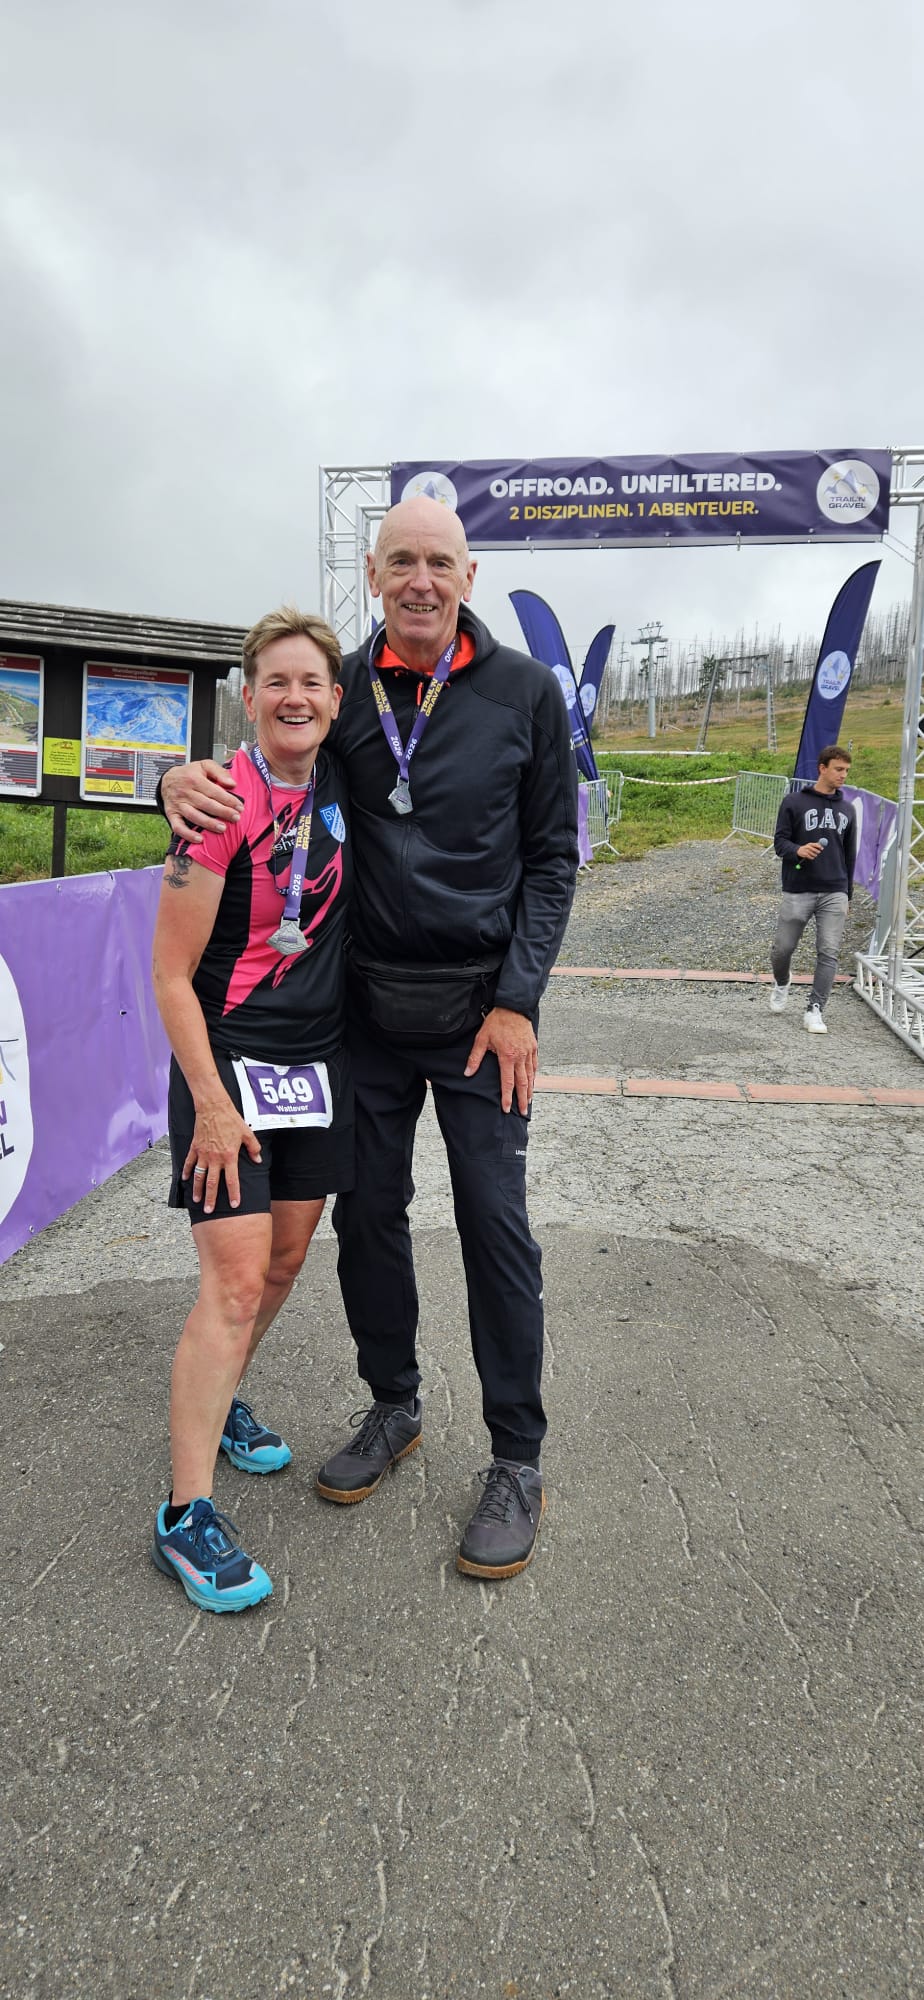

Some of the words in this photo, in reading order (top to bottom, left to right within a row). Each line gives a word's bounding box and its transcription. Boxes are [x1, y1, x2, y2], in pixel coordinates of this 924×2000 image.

[489, 477, 615, 498] OFFROAD.
[621, 472, 783, 495] UNFILTERED.
[509, 506, 520, 520] 2
[524, 503, 634, 520] DISZIPLINEN.
[637, 502, 645, 517] 1
[648, 500, 759, 517] ABENTEUER.
[425, 681, 444, 717] GRAVEL
[390, 735, 403, 757] 2026
[405, 737, 418, 761] 2026
[302, 813, 312, 850] GRAVEL
[804, 808, 849, 835] GAP
[291, 873, 302, 897] 2026
[258, 1076, 314, 1104] 549
